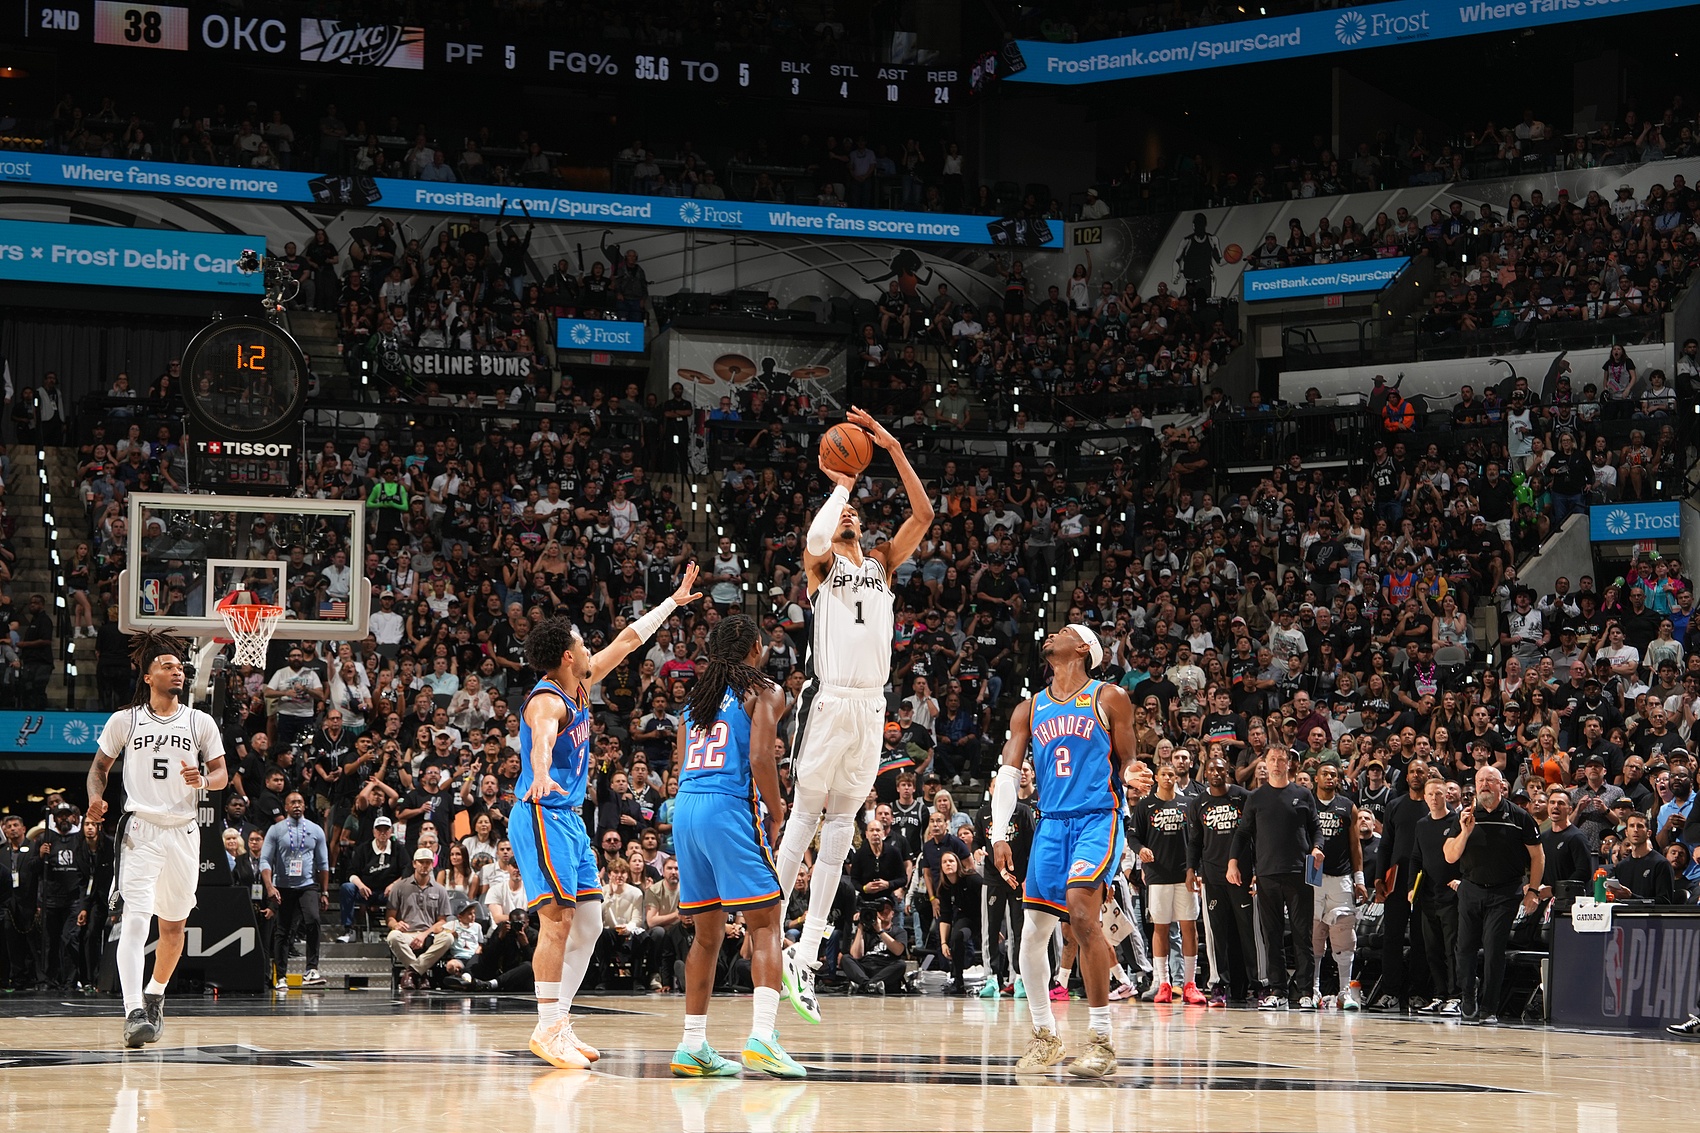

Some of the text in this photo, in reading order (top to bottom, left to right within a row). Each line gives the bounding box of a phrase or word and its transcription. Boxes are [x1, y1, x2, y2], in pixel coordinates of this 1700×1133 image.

[41, 8, 80, 31] 2ND
[1370, 9, 1430, 37] Frost
[1459, 1, 1527, 23] Where
[124, 10, 162, 44] 38
[202, 14, 287, 53] OKC
[319, 25, 385, 62] OKC
[1048, 26, 1301, 73] FrostBank.com/SpursCard
[446, 42, 516, 70] PF 5
[548, 50, 669, 82] FG% 35.6
[681, 60, 750, 87] TO 5
[781, 60, 811, 75] BLK
[830, 64, 859, 79] STL
[877, 68, 908, 82] AST
[927, 70, 958, 83] REB
[791, 77, 800, 96] 3
[839, 81, 849, 99] 4
[886, 84, 899, 102] 10
[934, 86, 950, 104] 24
[62, 163, 278, 193] Where fans score more
[415, 189, 652, 218] FrostBank.com/SpursCard
[704, 206, 743, 224] Frost
[769, 211, 960, 237] Where fans score more
[1075, 227, 1101, 244] 102
[51, 244, 119, 268] Frost
[124, 248, 190, 271] Debit
[1327, 295, 1341, 307] EXIT
[593, 327, 631, 345] Frost
[404, 354, 531, 378] SELINE BUMS
[222, 441, 292, 457] TISSOT
[560, 480, 575, 490] 20
[1633, 512, 1680, 530] Frost
[601, 544, 606, 553] 1
[658, 573, 664, 583] 1
[854, 601, 865, 624] 1
[1034, 714, 1097, 748] THUNDER
[134, 734, 191, 752] SPURS
[685, 719, 730, 771] 22
[153, 758, 169, 780] 5
[1054, 745, 1072, 778] 2
